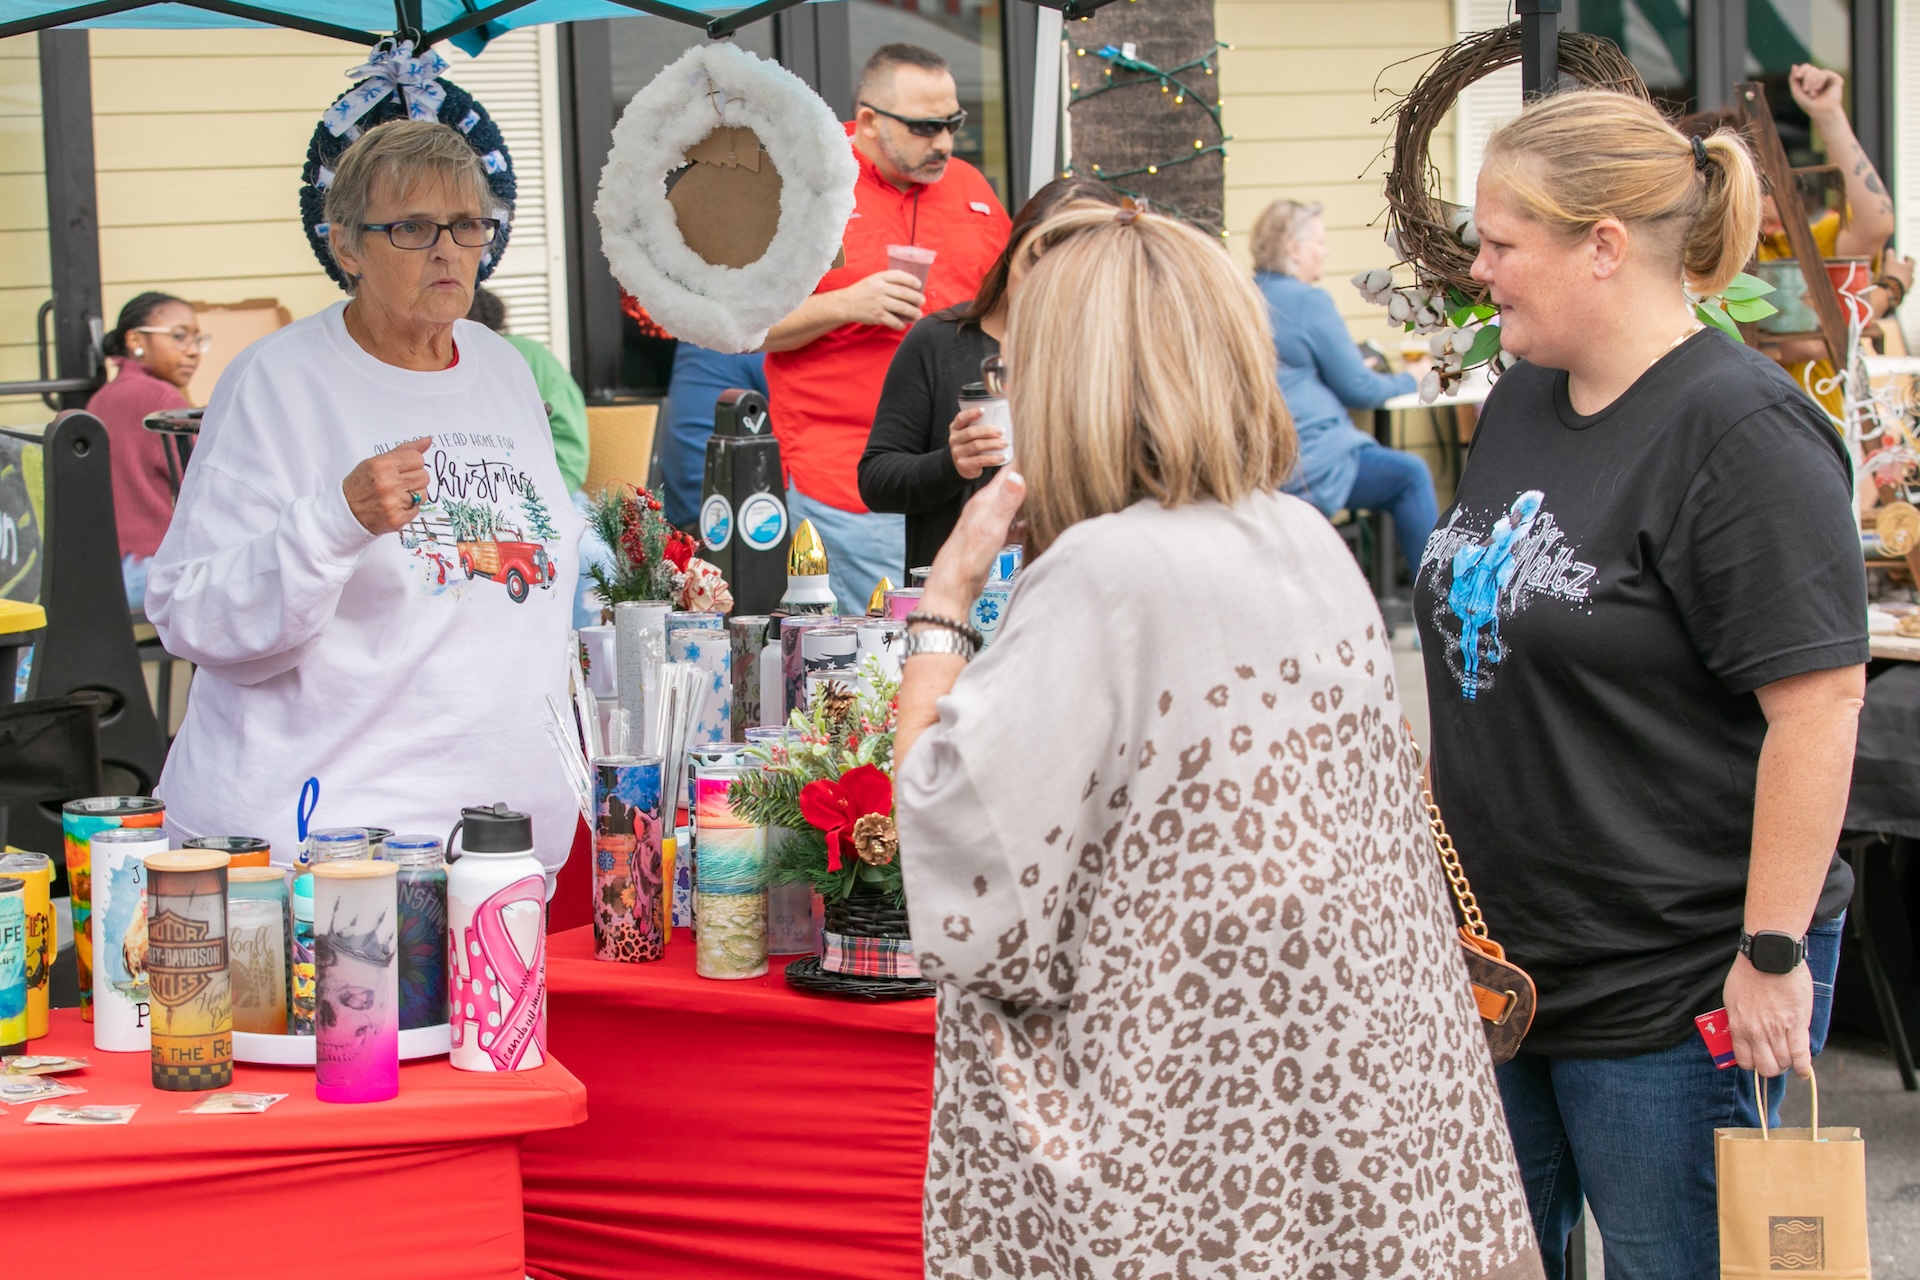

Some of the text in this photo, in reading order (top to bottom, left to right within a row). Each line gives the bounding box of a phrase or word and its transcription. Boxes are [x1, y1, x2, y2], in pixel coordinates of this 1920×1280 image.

[438, 432, 468, 449] LEAD
[469, 432, 497, 448] HOME
[497, 434, 516, 450] FOR
[514, 1026, 527, 1041] do
[170, 1047, 204, 1061] THE
